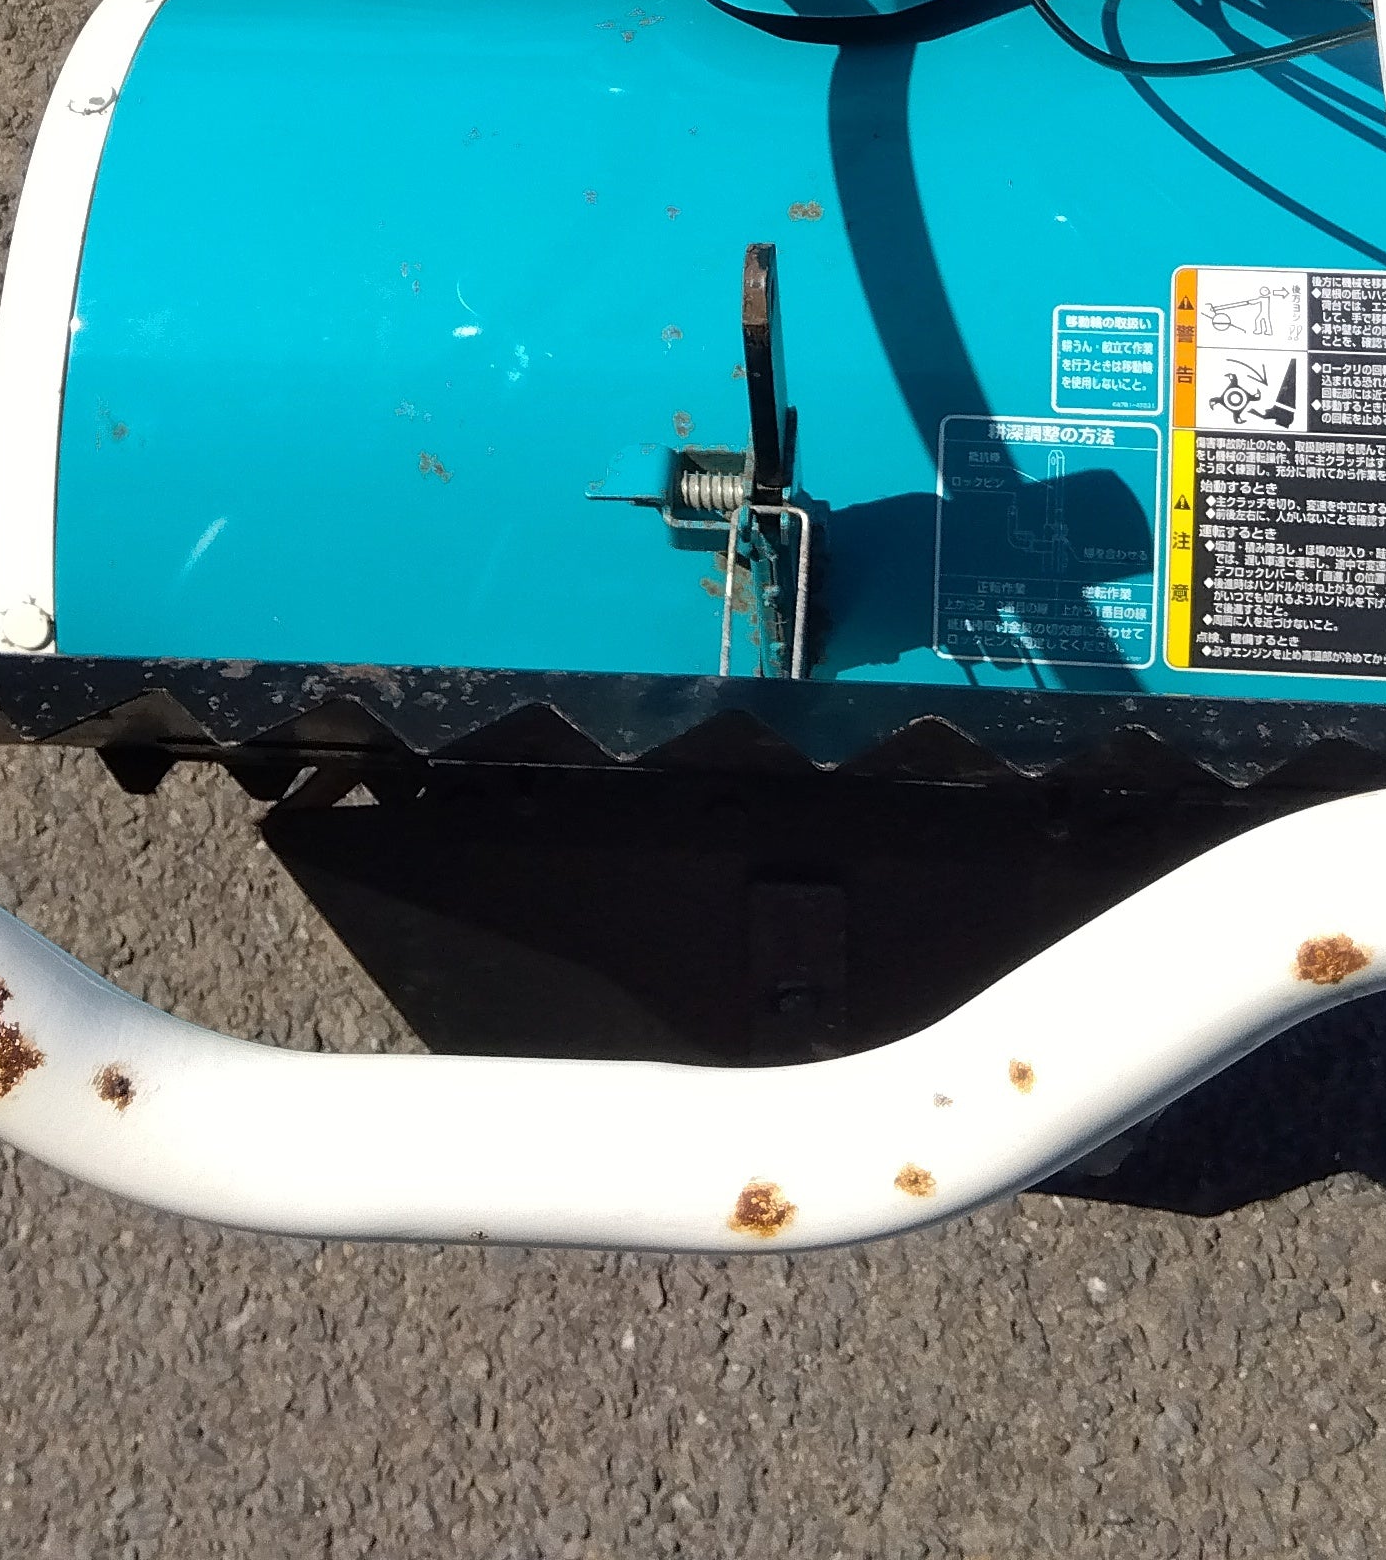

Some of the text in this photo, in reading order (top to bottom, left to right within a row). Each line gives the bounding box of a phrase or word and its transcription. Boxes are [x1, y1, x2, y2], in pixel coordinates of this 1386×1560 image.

[988, 424, 1115, 445] 耕深調整の方法
[1200, 479, 1278, 495] 始動するとき
[1199, 524, 1277, 539] 運転するとき
